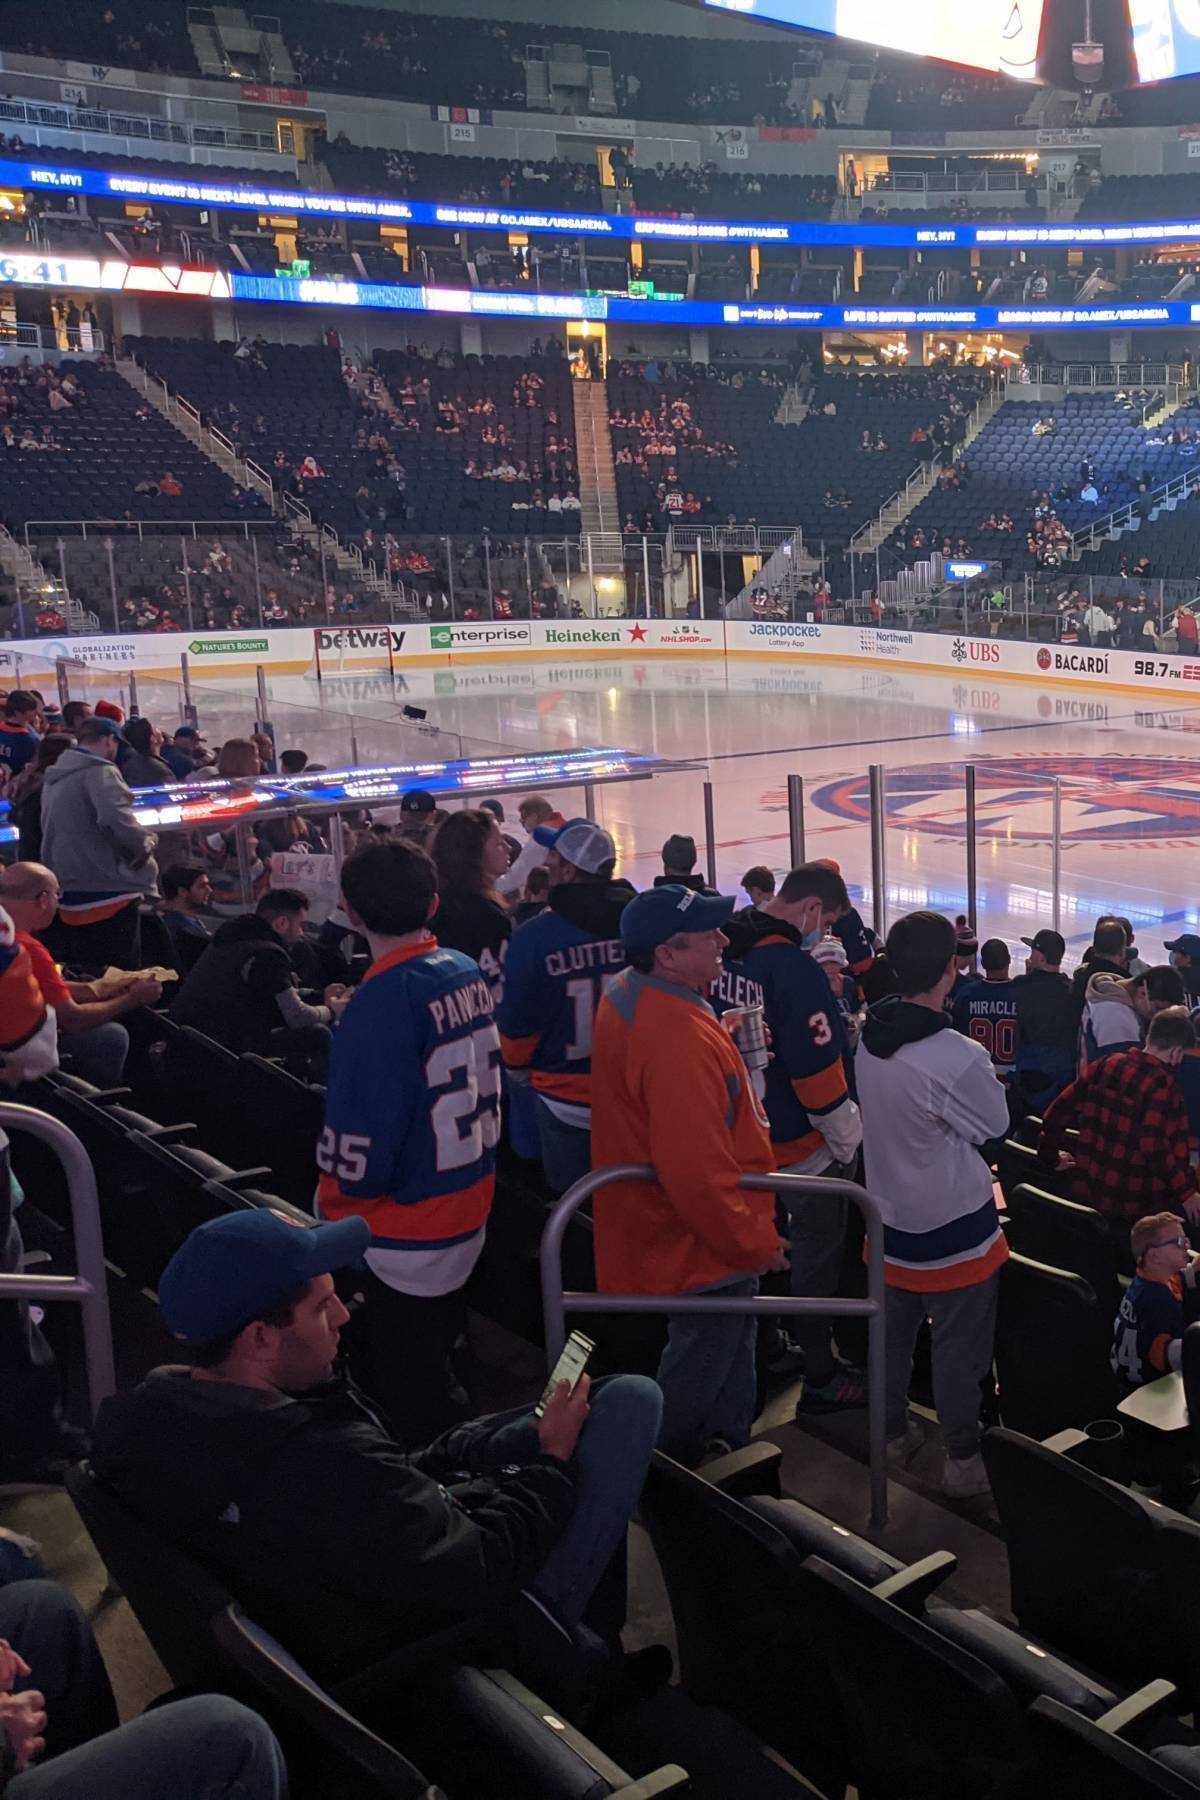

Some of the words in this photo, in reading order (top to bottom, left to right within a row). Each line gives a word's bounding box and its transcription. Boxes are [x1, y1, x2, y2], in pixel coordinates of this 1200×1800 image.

[454, 129, 471, 138] 215
[31, 170, 59, 185] HEY,
[59, 173, 82, 186] NY!
[147, 182, 188, 198] EVENT
[485, 212, 500, 225] AT
[916, 231, 938, 242] HEY,
[937, 231, 956, 241] NY!
[437, 628, 529, 645] enterprise
[545, 628, 622, 644] Heineken
[749, 624, 821, 640] Jackpocket
[876, 631, 913, 646] Northwell
[72, 643, 136, 655] GLOBALIZATION
[201, 642, 233, 653] NATURE'S
[234, 640, 267, 651] BOUNTY
[317, 629, 406, 653] betway
[768, 639, 789, 648] Lottery
[790, 640, 805, 649] App
[74, 651, 136, 662] PARTNERS
[876, 644, 900, 656] Health
[969, 642, 1000, 662] UBS
[1055, 653, 1109, 674] BACARDÍ
[1134, 660, 1169, 677] 98.7
[1169, 670, 1181, 678] FM
[545, 943, 624, 976] CLUTTE
[710, 969, 764, 1007] PELECH
[969, 1000, 1017, 1016] MIRACLE
[808, 1010, 832, 1046] 3
[424, 1018, 503, 1173] 25
[315, 1124, 372, 1183] 25
